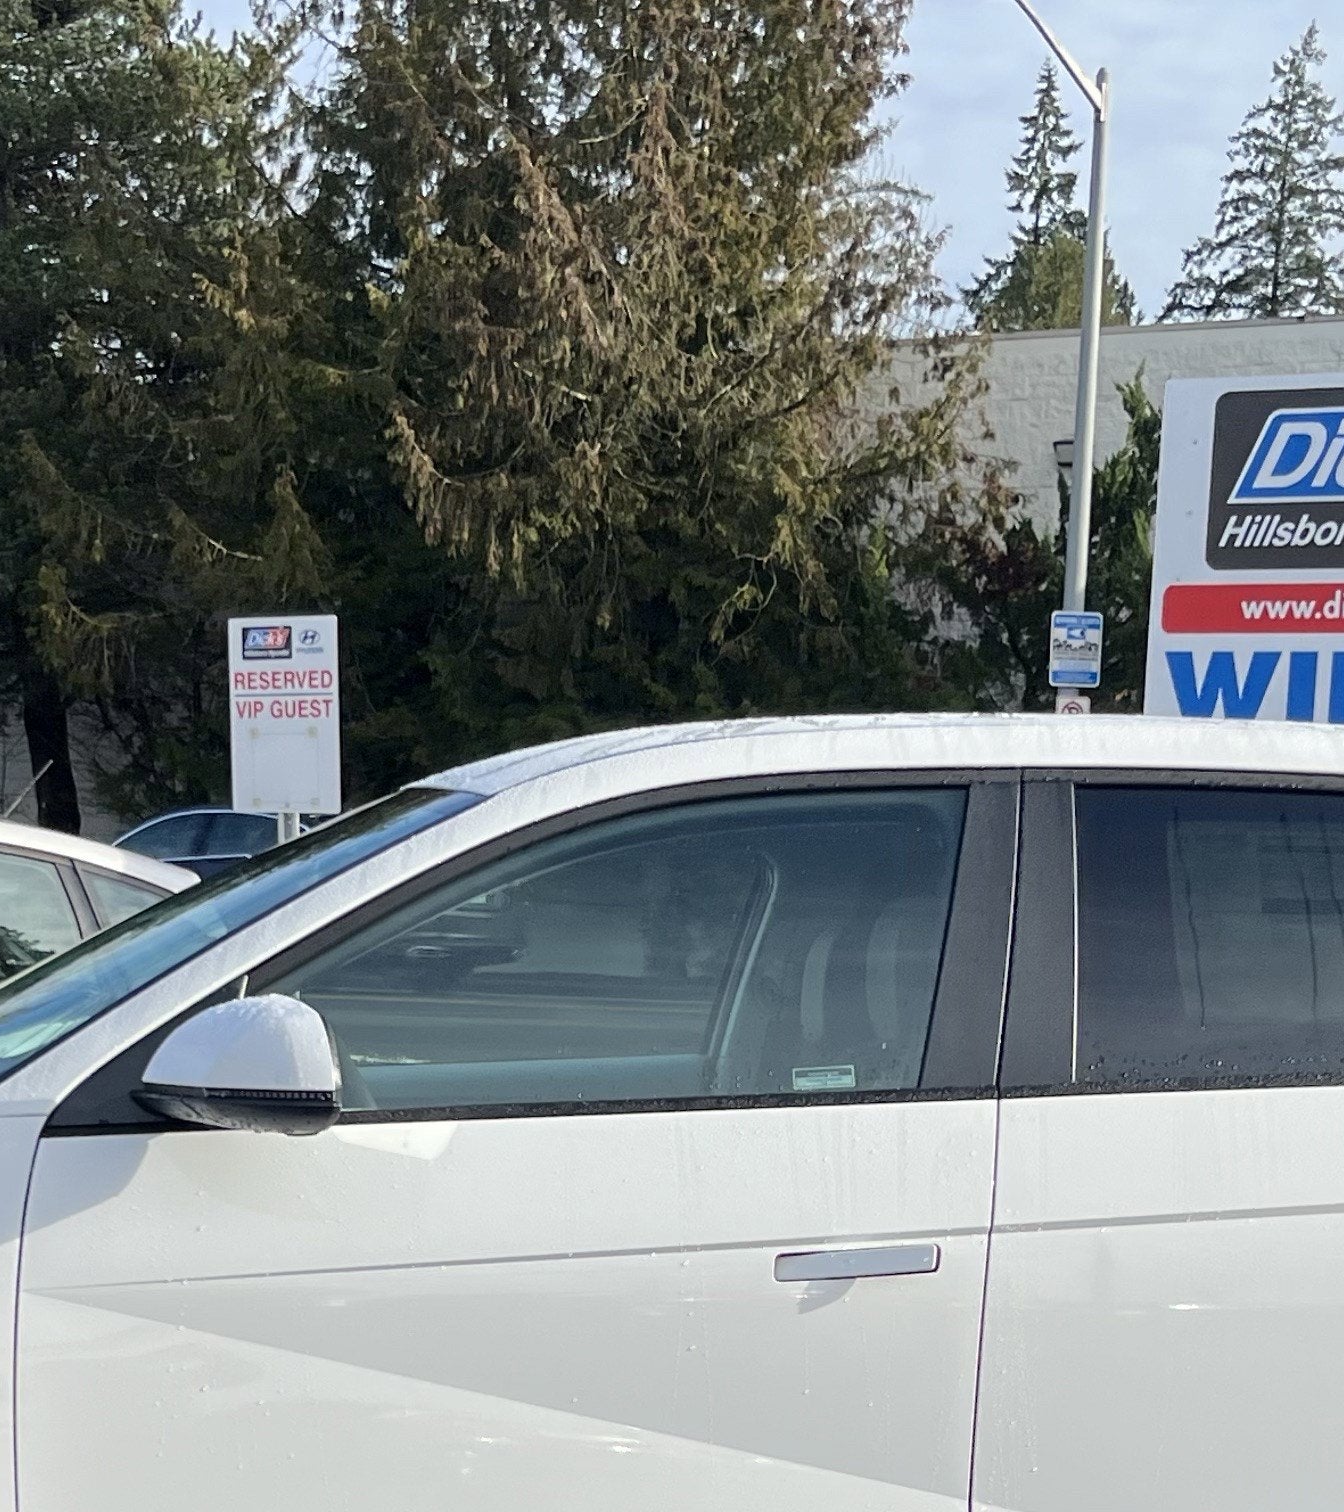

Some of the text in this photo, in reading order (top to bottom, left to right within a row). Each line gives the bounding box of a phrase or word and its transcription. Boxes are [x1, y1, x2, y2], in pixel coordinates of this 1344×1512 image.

[234, 670, 333, 690] RESERVED
[236, 699, 333, 718] VIP GUEST
